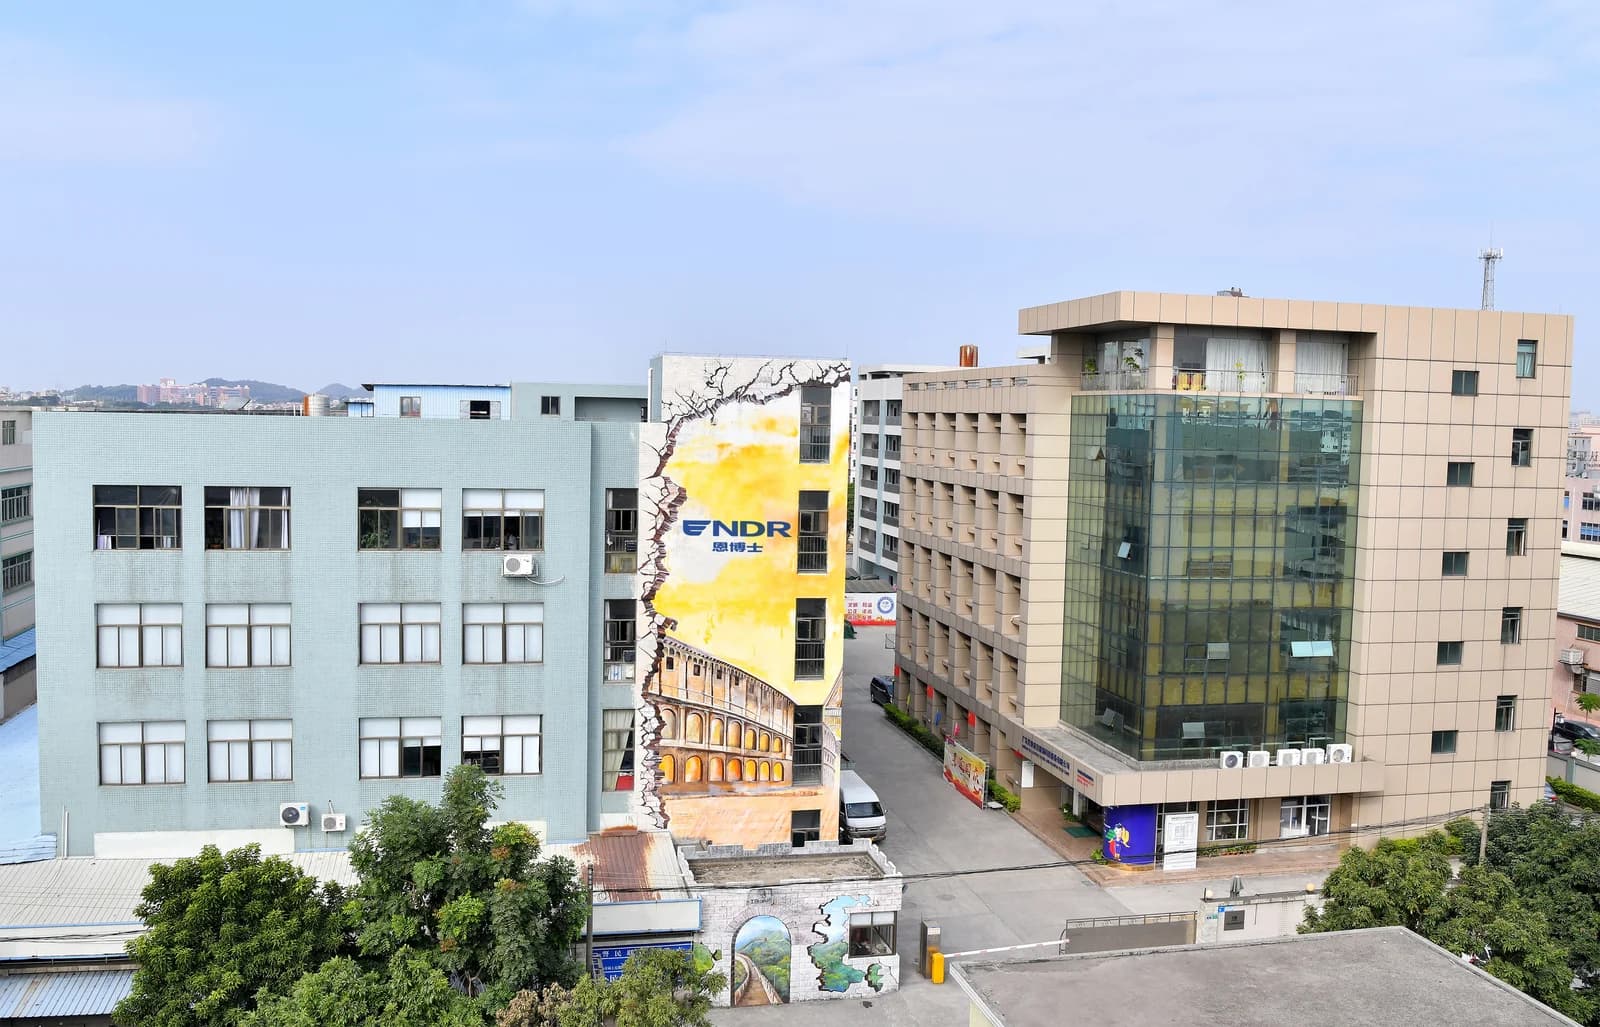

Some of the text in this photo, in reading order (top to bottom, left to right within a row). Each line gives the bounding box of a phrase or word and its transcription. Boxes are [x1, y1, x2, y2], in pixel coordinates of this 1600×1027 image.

[683, 520, 792, 537] ENDR
[712, 542, 763, 552] 恩博士
